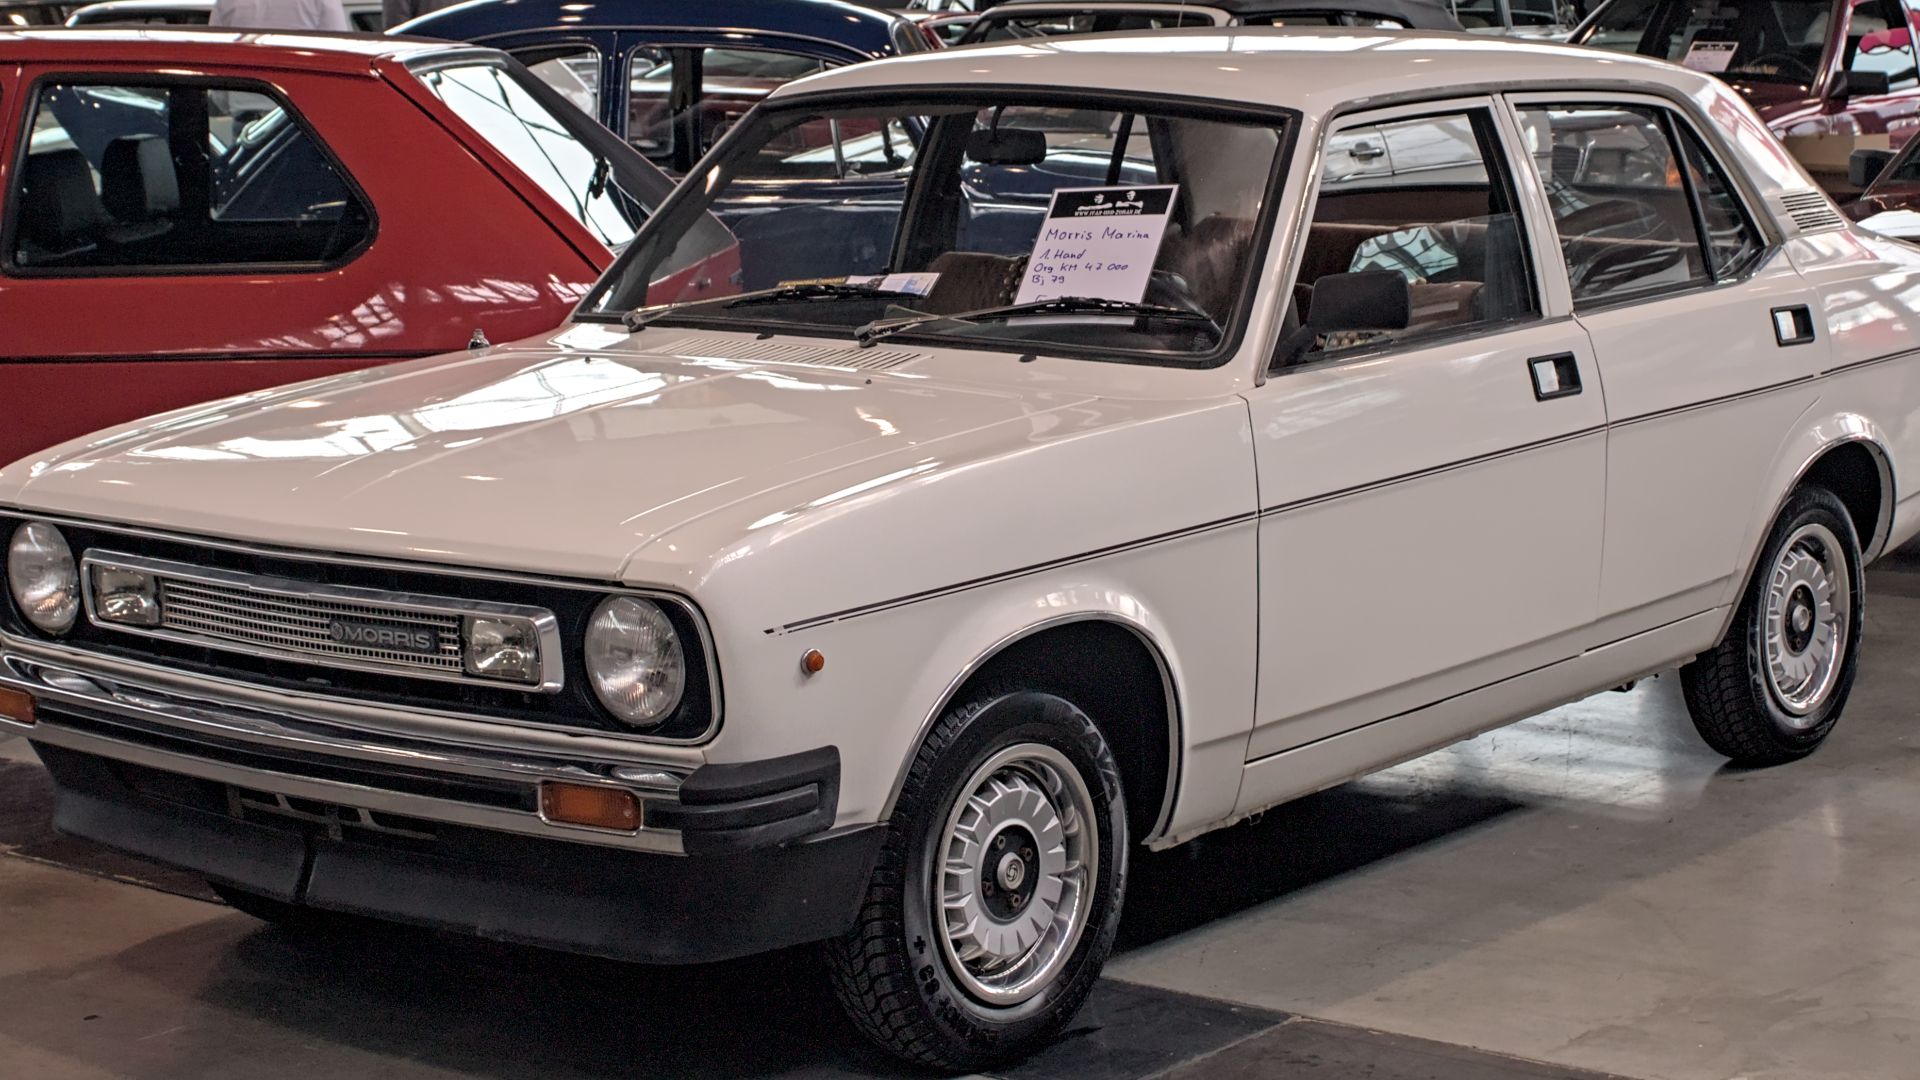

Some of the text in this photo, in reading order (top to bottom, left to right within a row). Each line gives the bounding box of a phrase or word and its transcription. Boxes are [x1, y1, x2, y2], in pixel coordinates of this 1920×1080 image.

[1045, 226, 1150, 241] Morris Marina
[1053, 248, 1087, 260] Hand
[1033, 262, 1054, 274] Org
[344, 626, 431, 649] MORRIS
